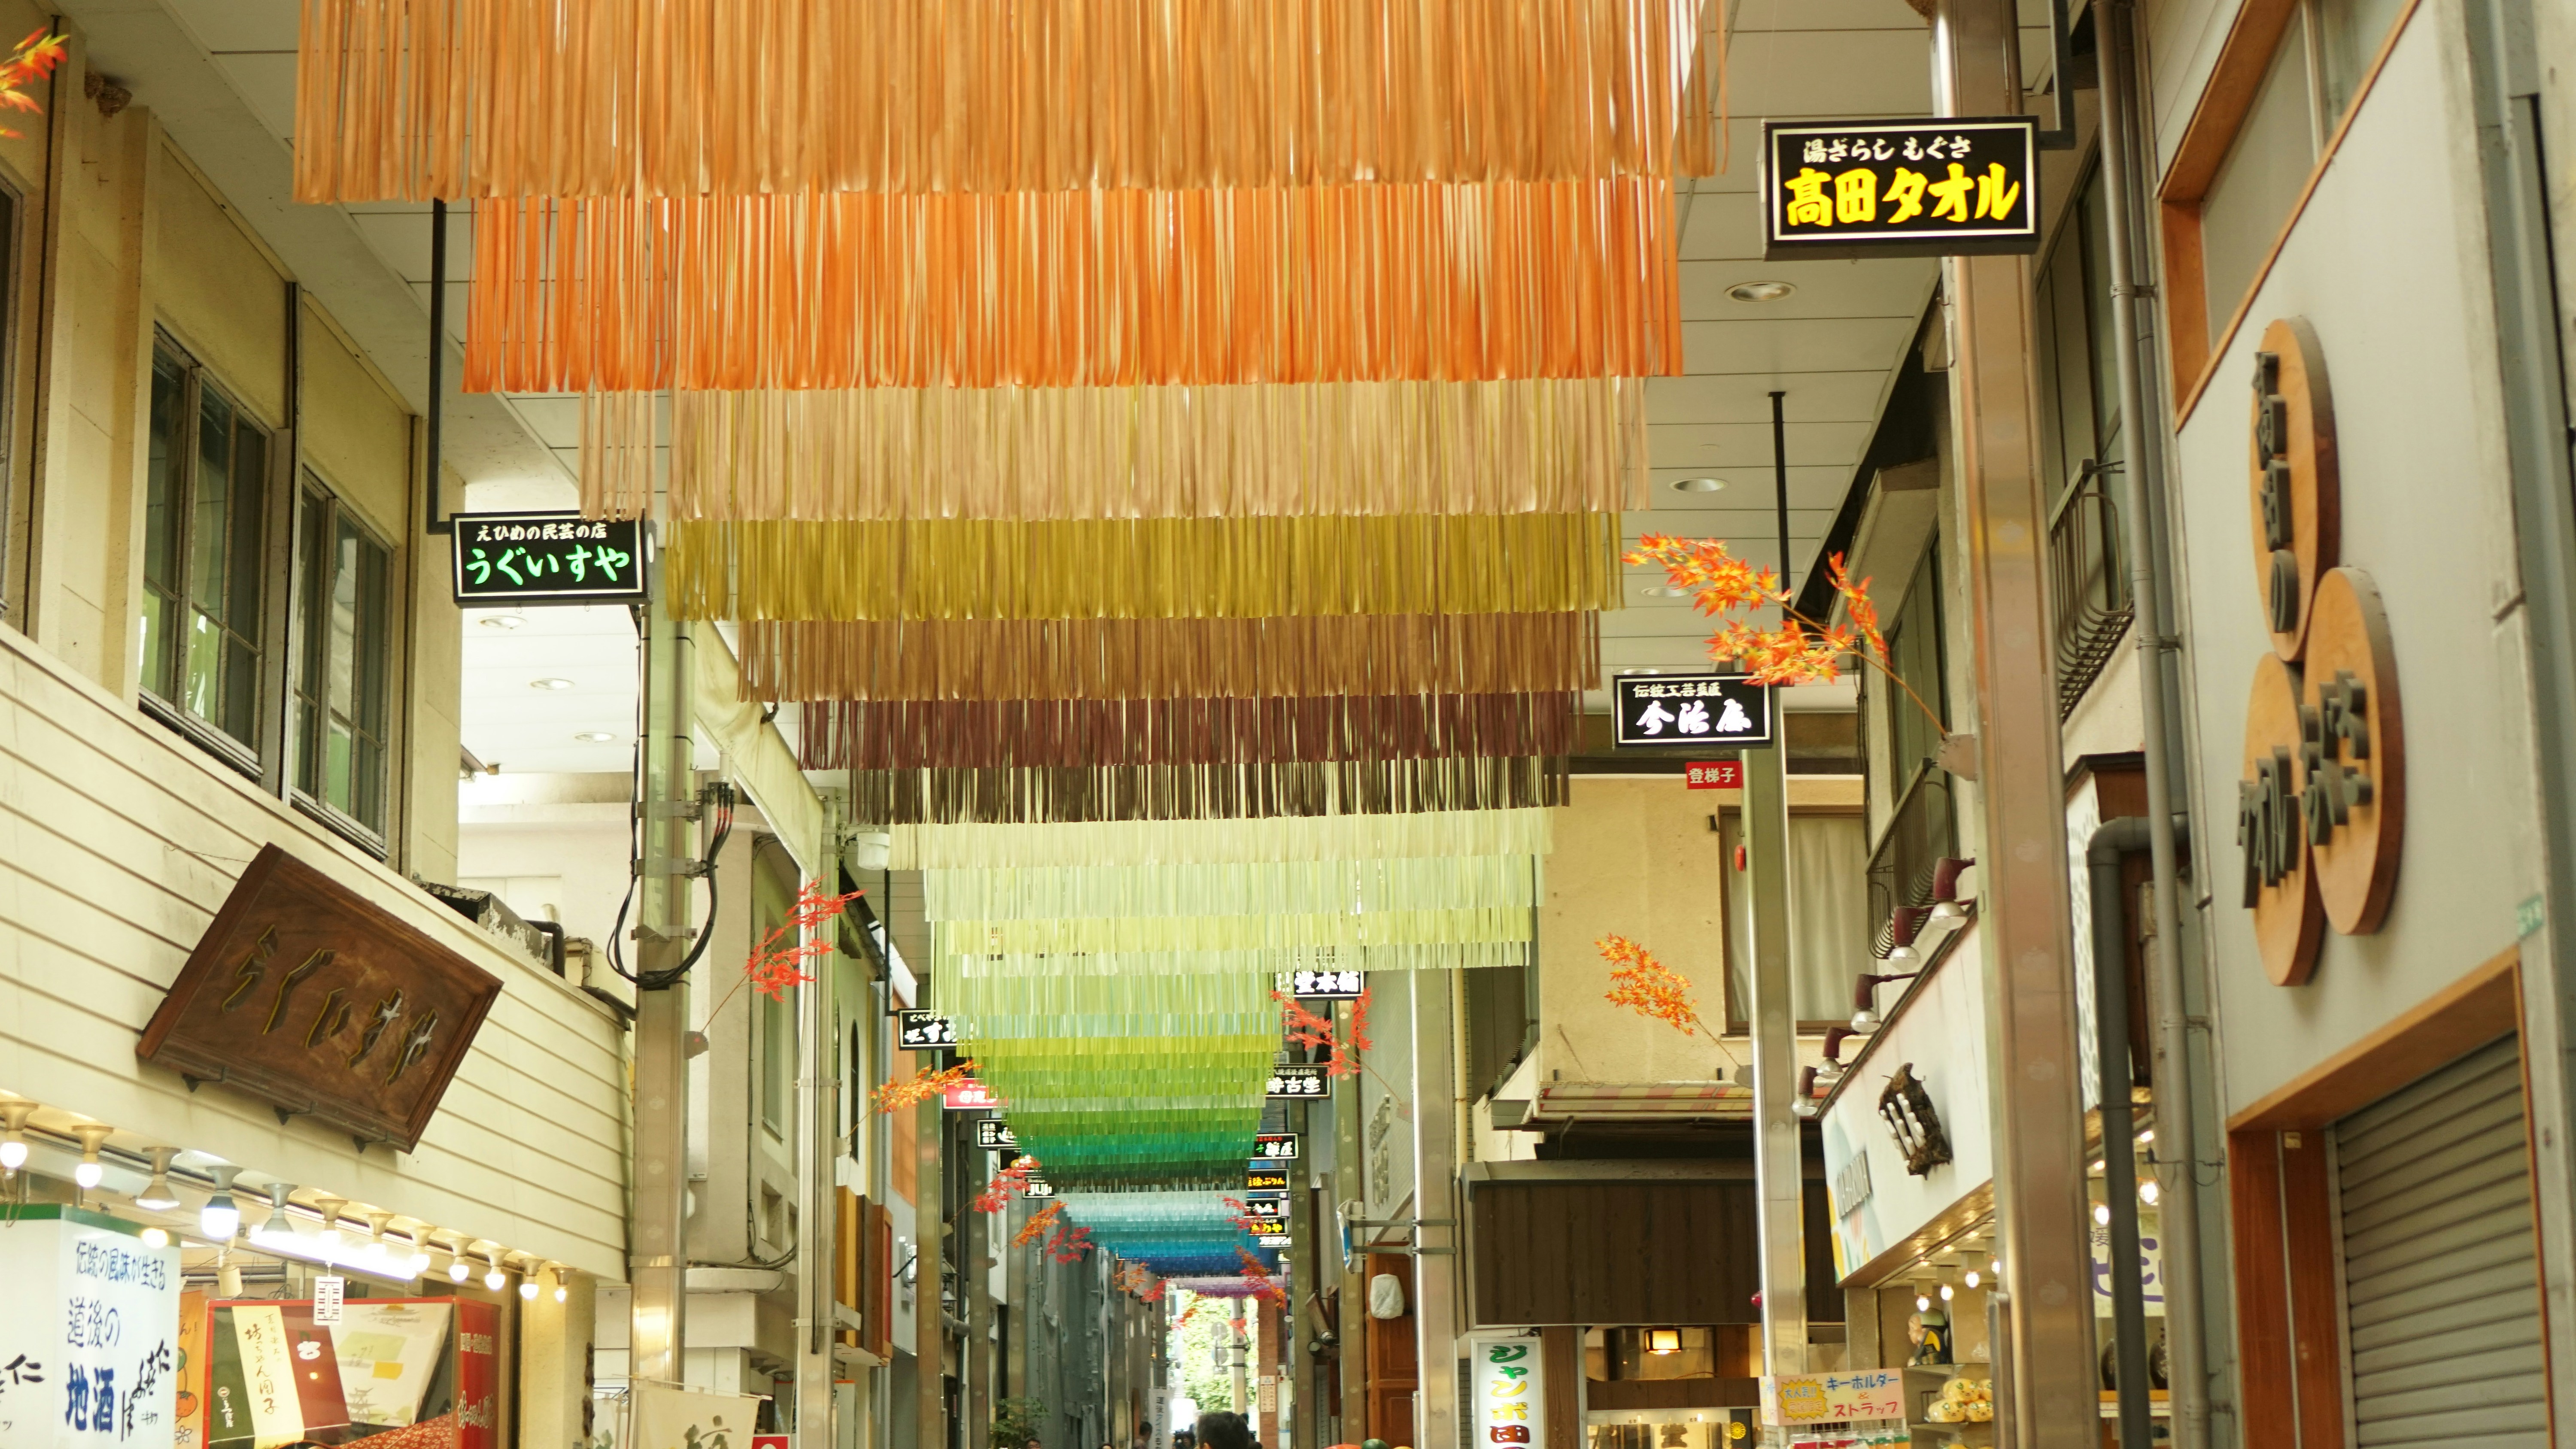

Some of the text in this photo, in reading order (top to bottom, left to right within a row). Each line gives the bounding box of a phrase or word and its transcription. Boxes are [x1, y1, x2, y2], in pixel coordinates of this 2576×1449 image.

[1803, 135, 1971, 163] 湯ざらし もぐさ
[476, 522, 607, 542] えひめの民芸の店
[466, 544, 630, 585] うぐいすや
[1688, 768, 1735, 784] 登梯子
[76, 1241, 166, 1291] 伝統の風味が生きる
[68, 1297, 120, 1348] 道後の
[1784, 1386, 1817, 1399] 大人気!!
[1826, 1373, 1899, 1391] キーホルダー
[65, 1361, 115, 1433] 地酒
[1489, 1345, 1531, 1449] ジャンボ団
[1834, 1401, 1898, 1417] ストラップ
